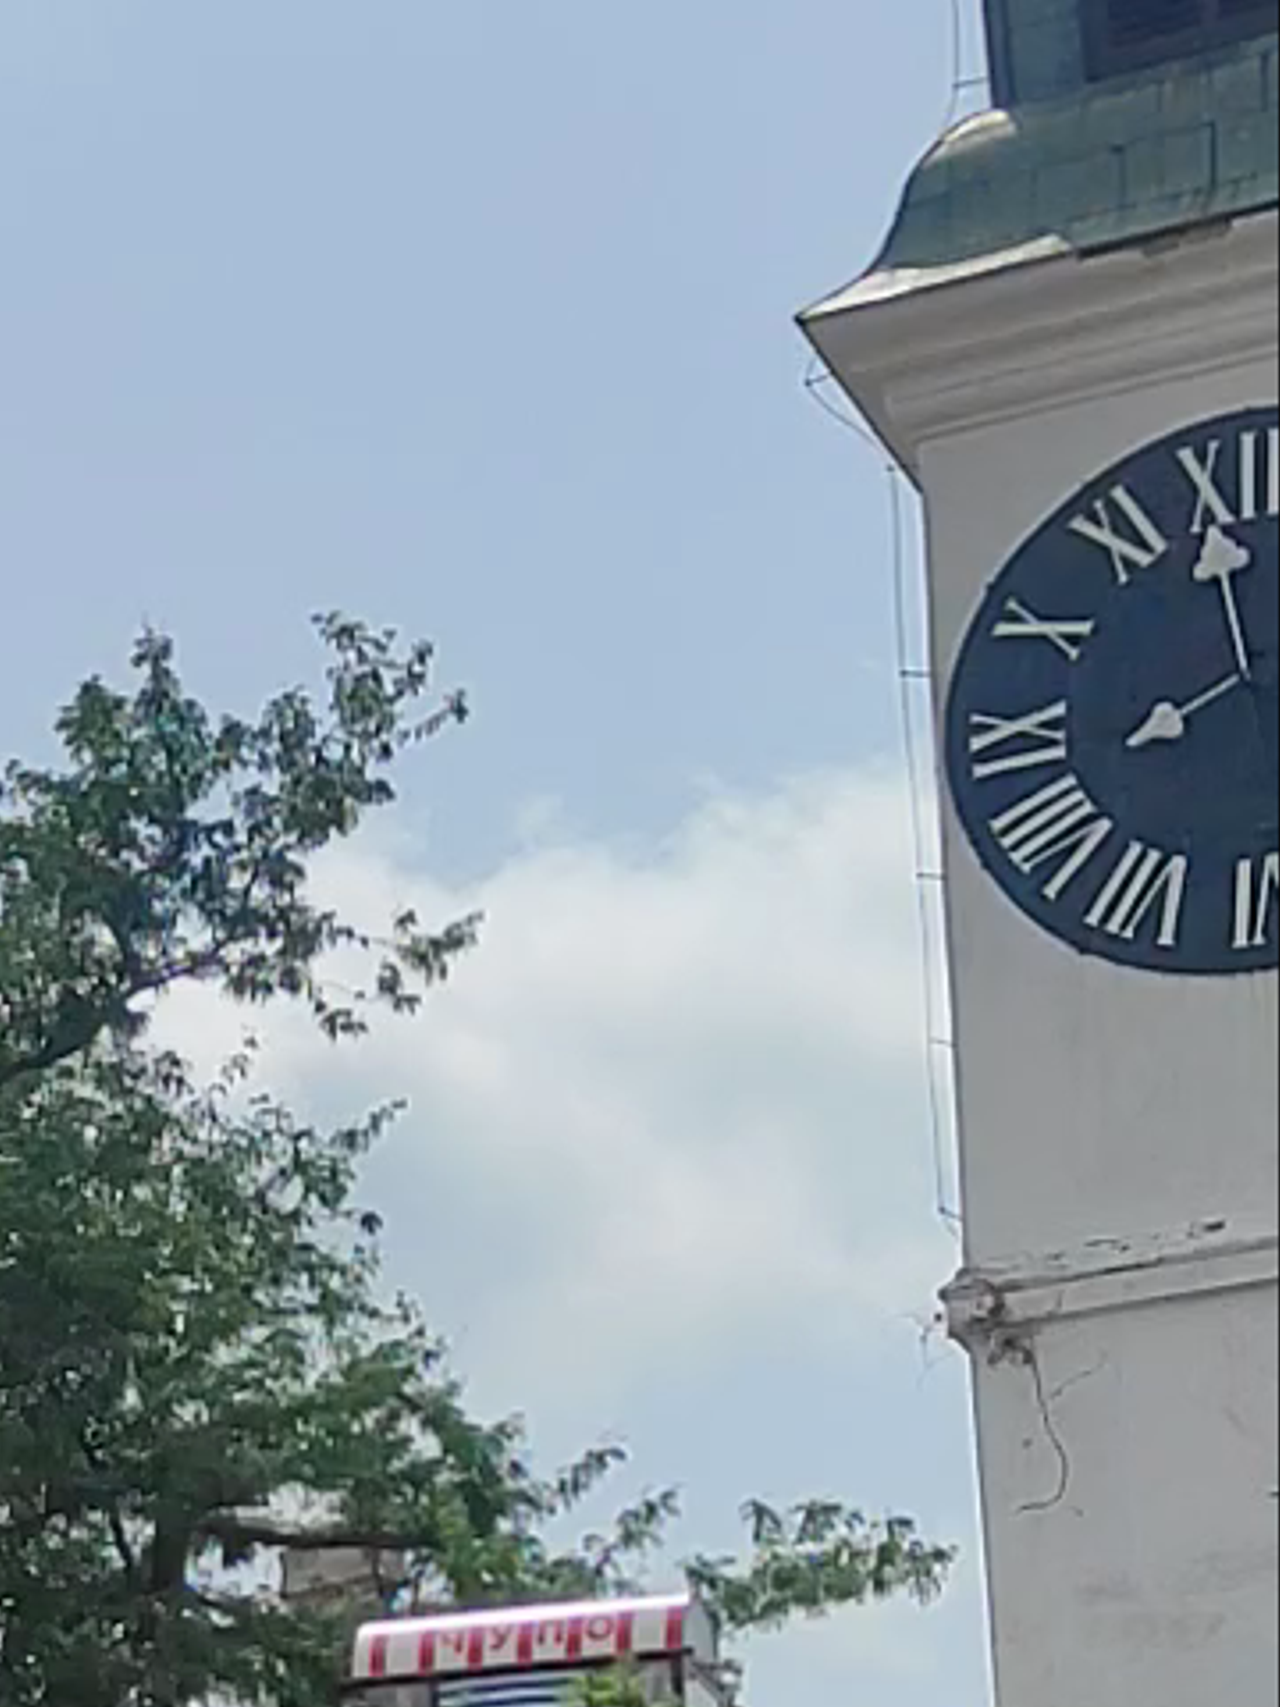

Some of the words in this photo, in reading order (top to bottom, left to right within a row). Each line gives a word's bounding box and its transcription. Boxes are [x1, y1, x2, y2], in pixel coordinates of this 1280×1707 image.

[1175, 427, 1279, 533] XII
[1068, 484, 1168, 585] XI
[992, 597, 1093, 660] X
[969, 700, 1067, 779] IX
[988, 773, 1113, 901] VIII
[1083, 840, 1187, 946] VII
